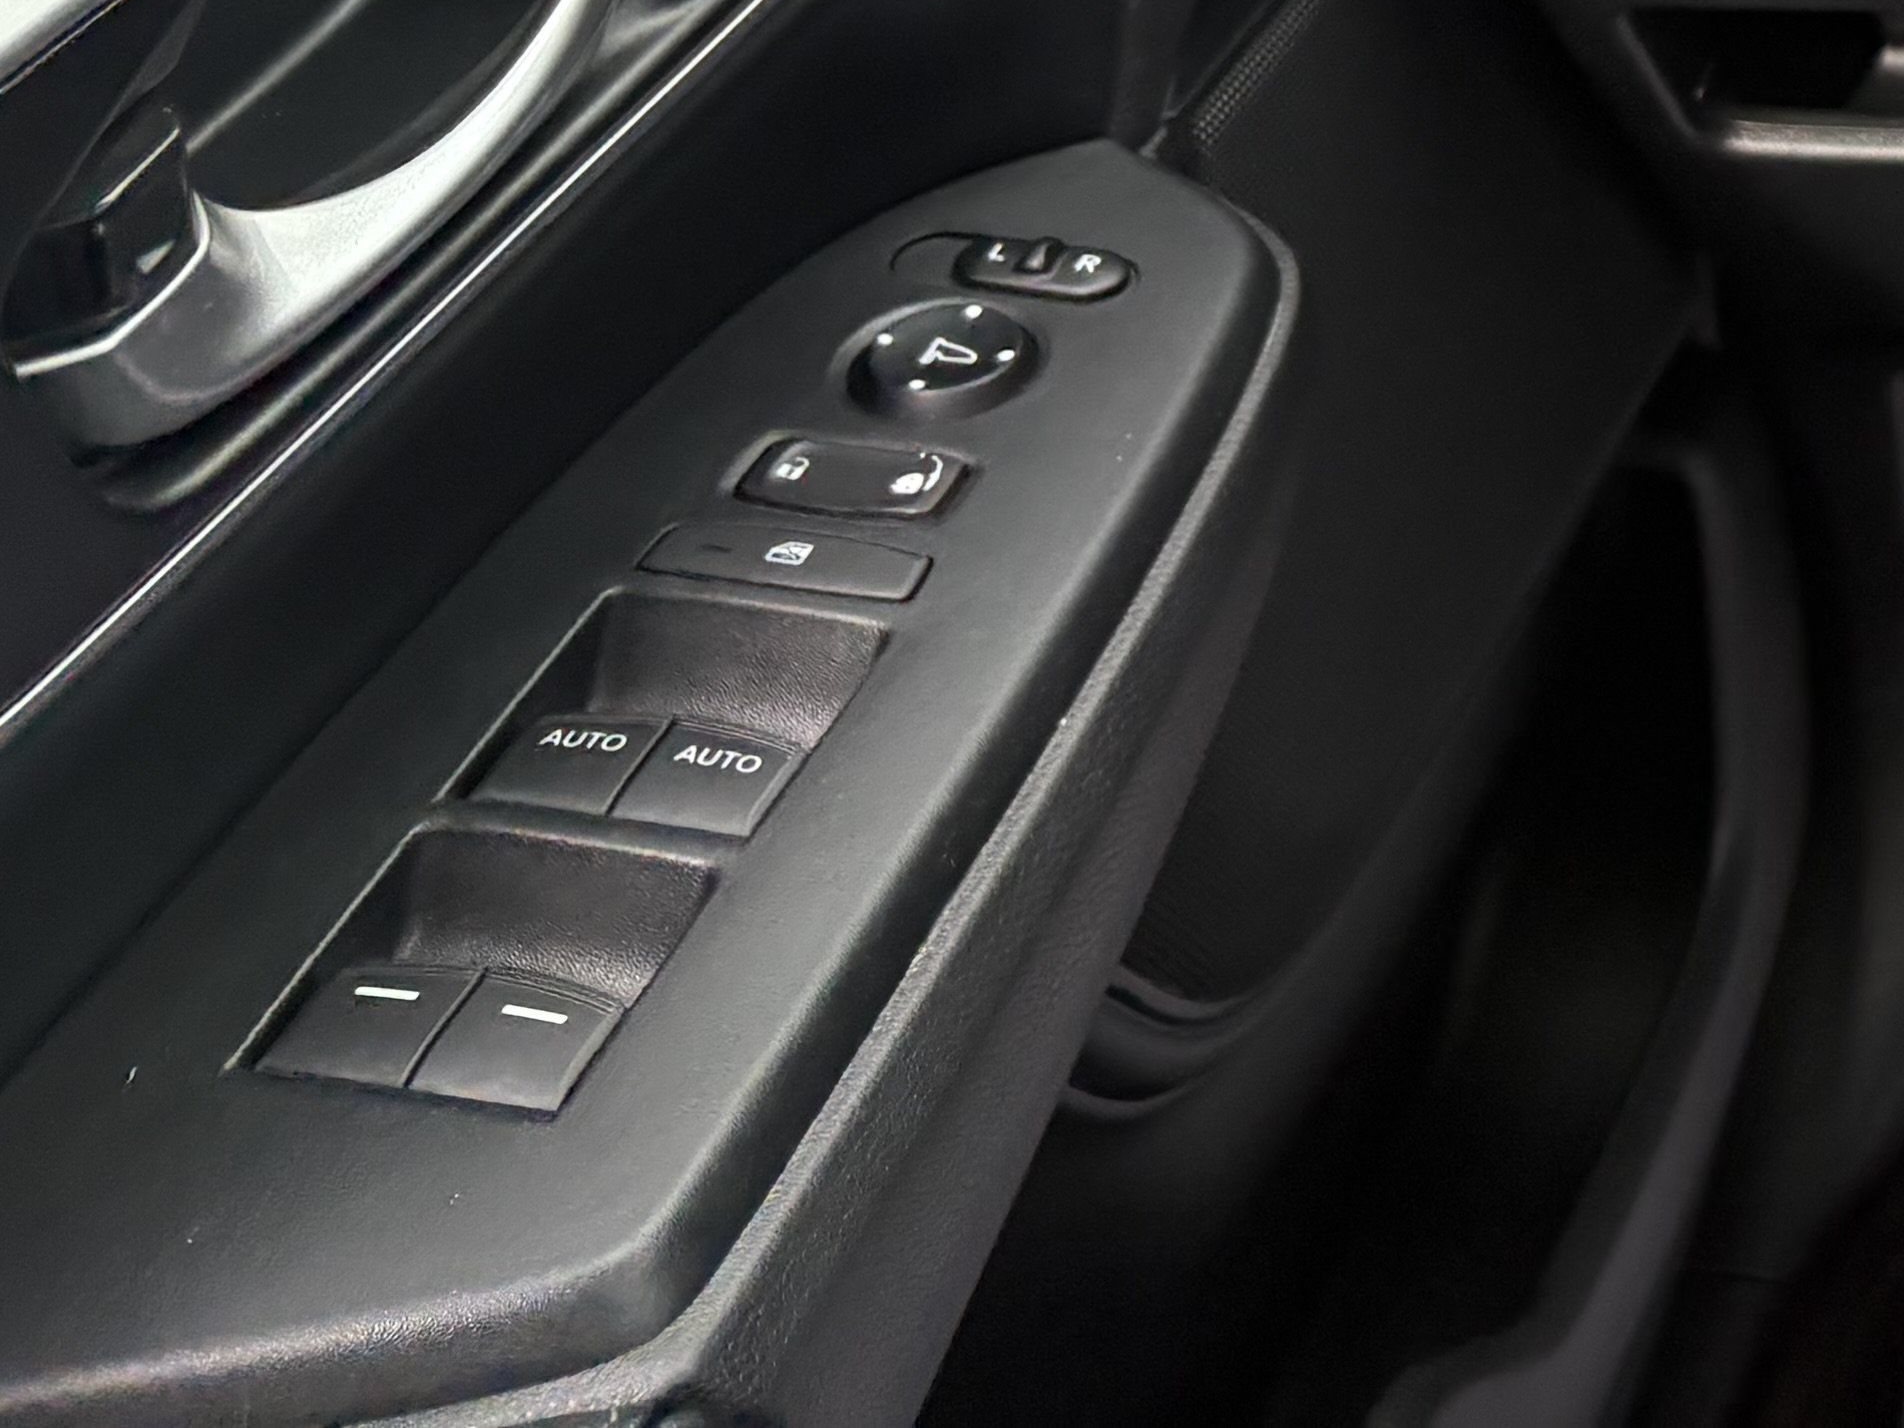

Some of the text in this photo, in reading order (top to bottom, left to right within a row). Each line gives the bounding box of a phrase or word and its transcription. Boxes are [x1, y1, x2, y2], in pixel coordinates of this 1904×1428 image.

[988, 242, 1006, 263] L
[1074, 253, 1102, 273] R
[538, 729, 629, 753] AUTO
[673, 745, 763, 774] AUTO
